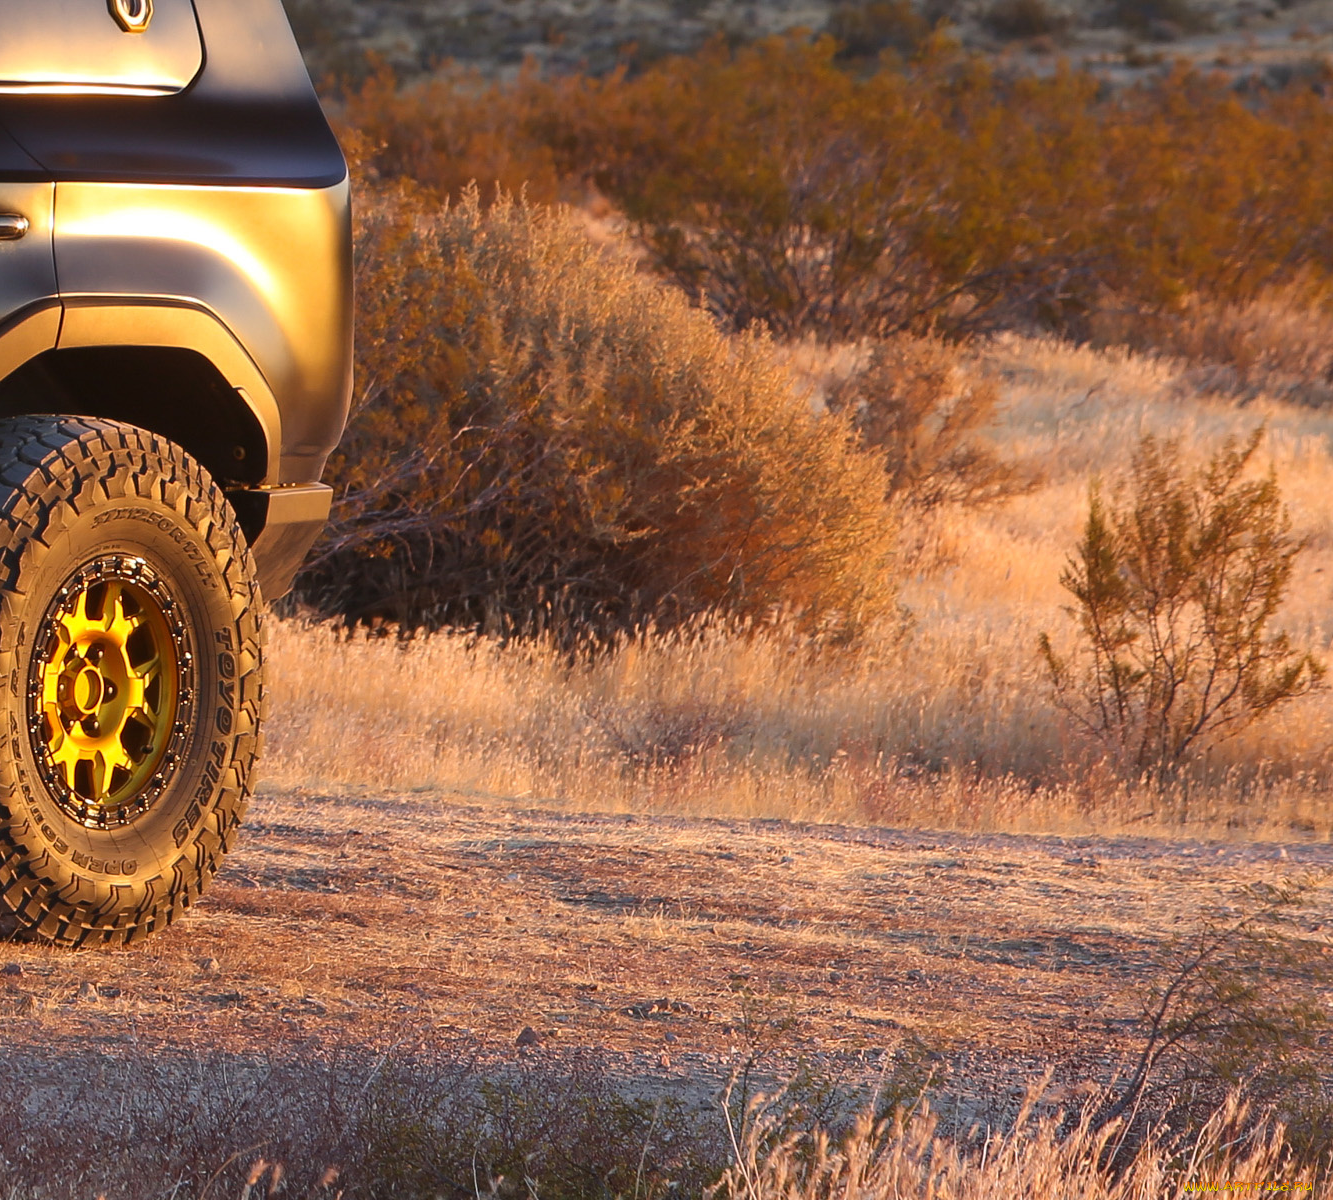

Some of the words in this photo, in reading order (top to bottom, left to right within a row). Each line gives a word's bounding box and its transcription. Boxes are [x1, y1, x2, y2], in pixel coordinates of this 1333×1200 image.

[215, 626, 235, 735] TOYO
[171, 741, 227, 849] TIRES
[71, 848, 138, 877] OPEN
